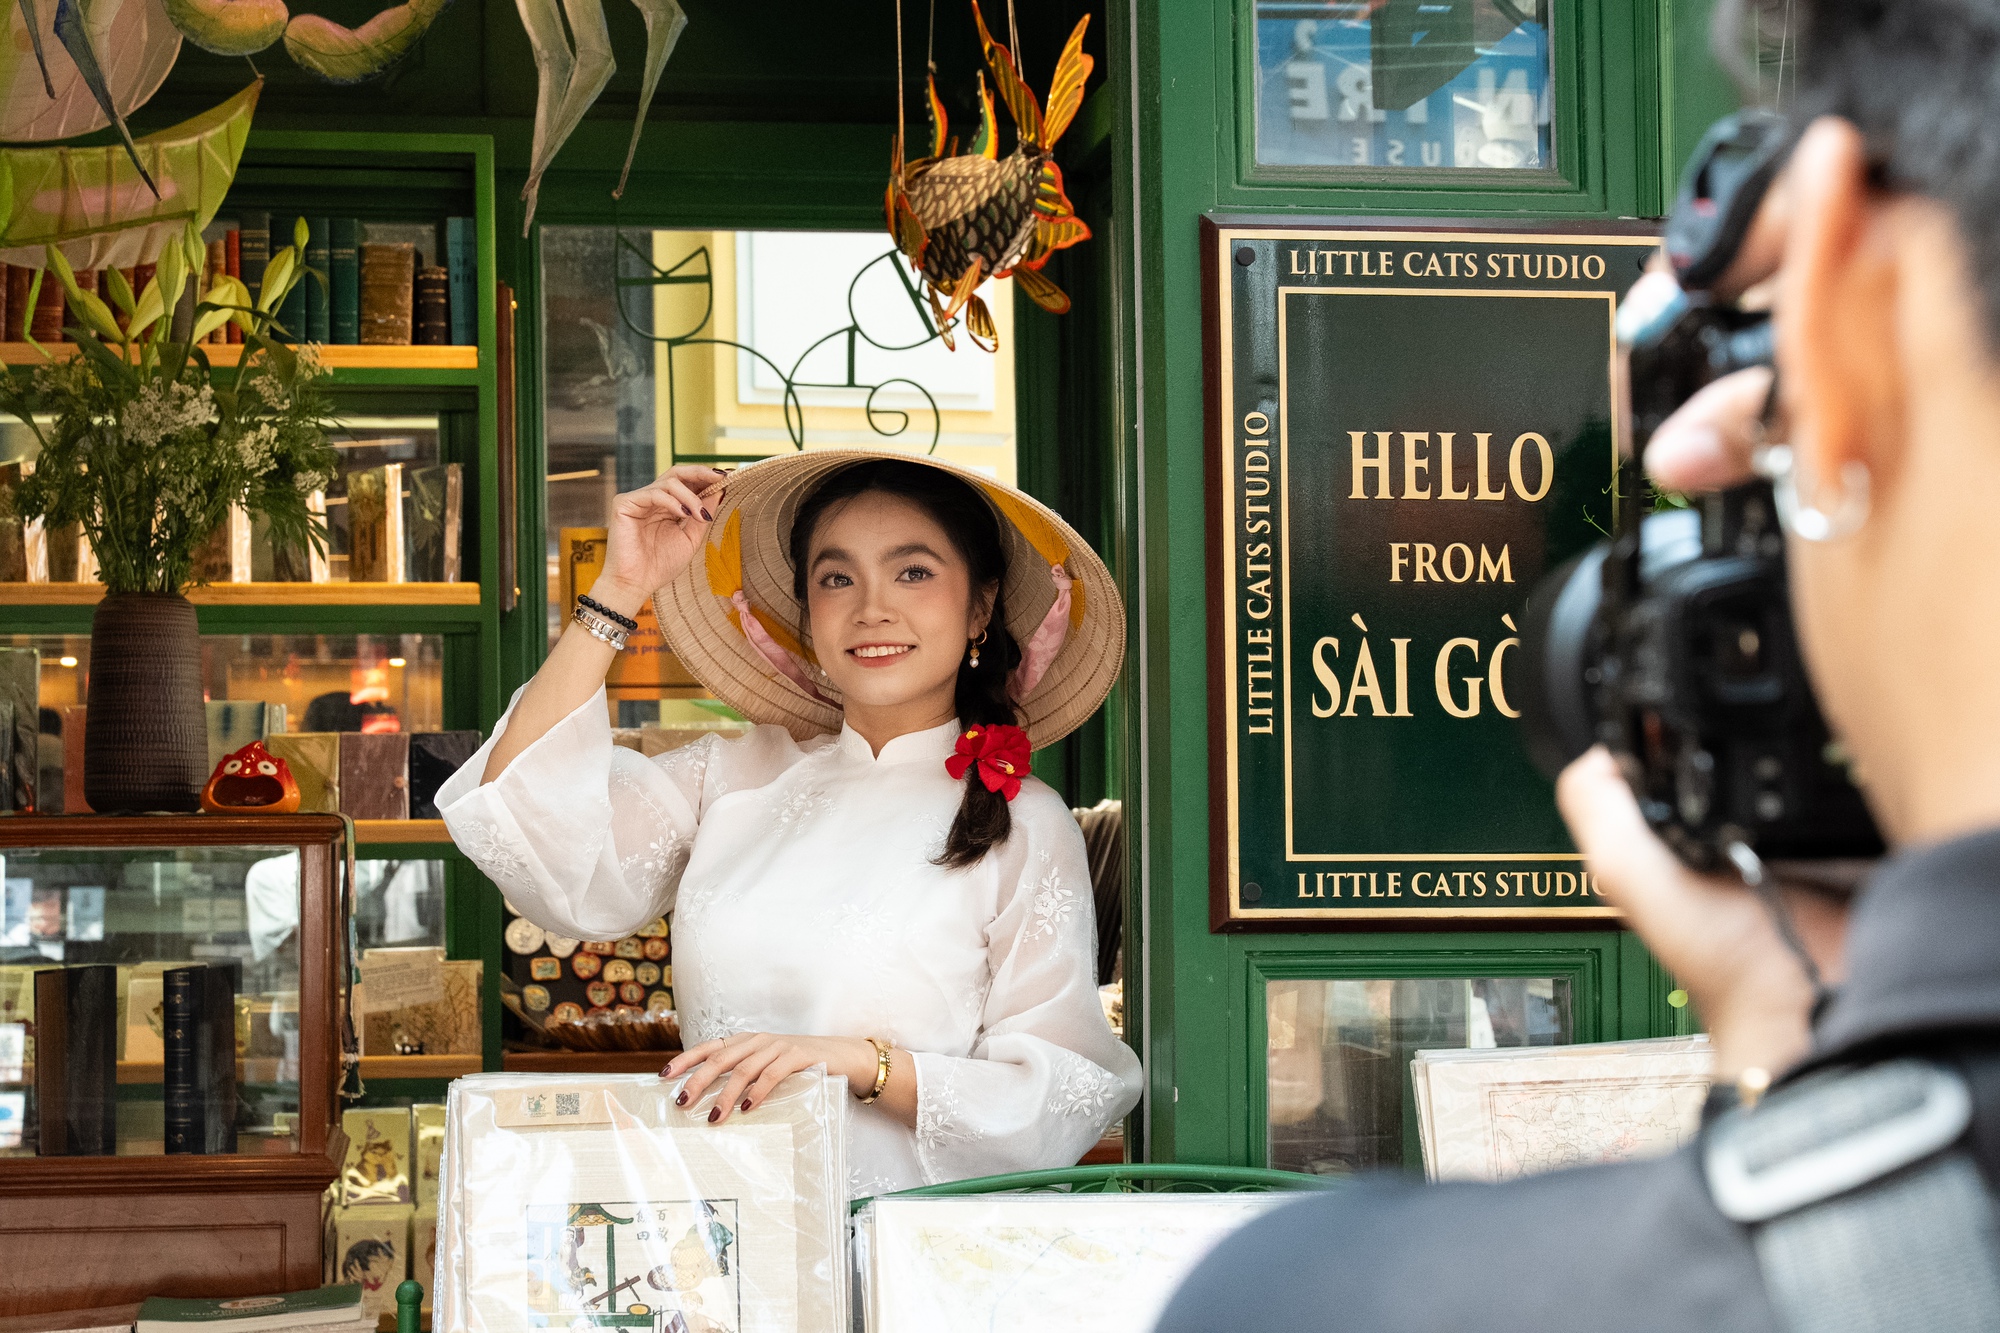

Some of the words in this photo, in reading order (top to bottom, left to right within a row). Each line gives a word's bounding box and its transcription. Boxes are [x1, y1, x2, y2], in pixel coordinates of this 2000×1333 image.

[1290, 250, 1394, 276] LITTLE
[1402, 251, 1479, 278] CATS
[1486, 253, 1606, 280] STUDIO
[1244, 411, 1270, 534] STUDIO
[1347, 431, 1554, 502] HELLO
[1246, 543, 1272, 620] CATS
[1388, 542, 1516, 583] FROM
[1247, 628, 1274, 735] LITTLE
[1311, 612, 1414, 718] SÀI
[1434, 613, 1521, 719] GÒ
[1298, 872, 1402, 898] LITTLE
[1411, 871, 1487, 898] CATS
